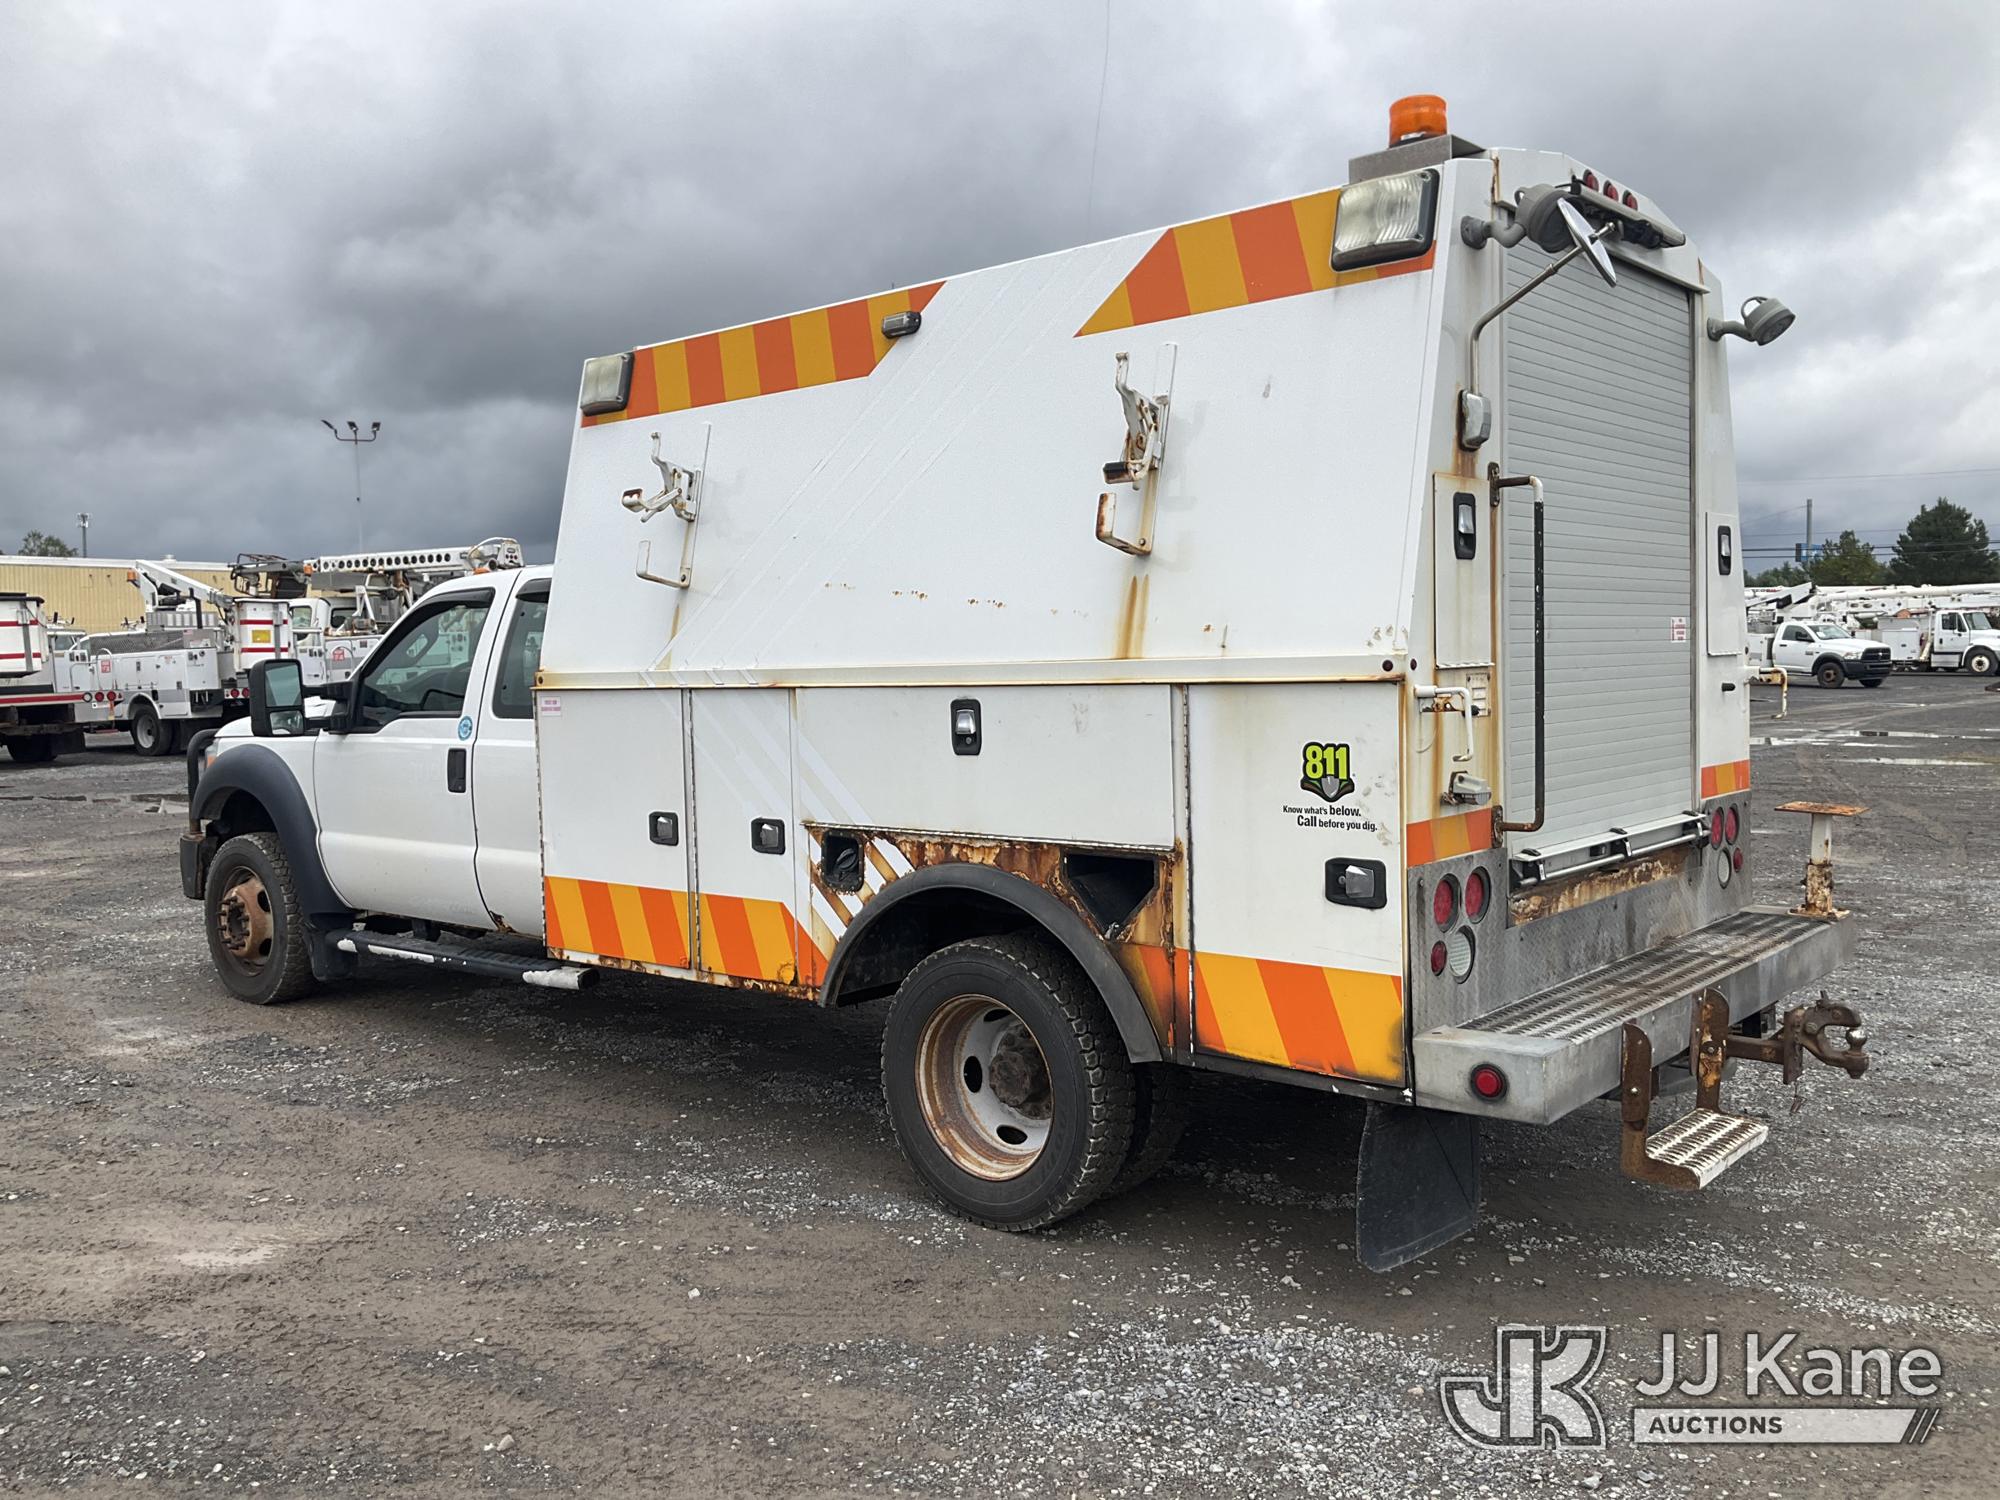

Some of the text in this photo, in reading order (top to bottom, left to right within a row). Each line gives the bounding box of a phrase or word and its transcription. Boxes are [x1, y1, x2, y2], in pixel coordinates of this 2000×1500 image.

[1305, 745, 1348, 779] 811
[1282, 805, 1361, 817] Know what's below.
[1297, 815, 1378, 832] Call before you dig.
